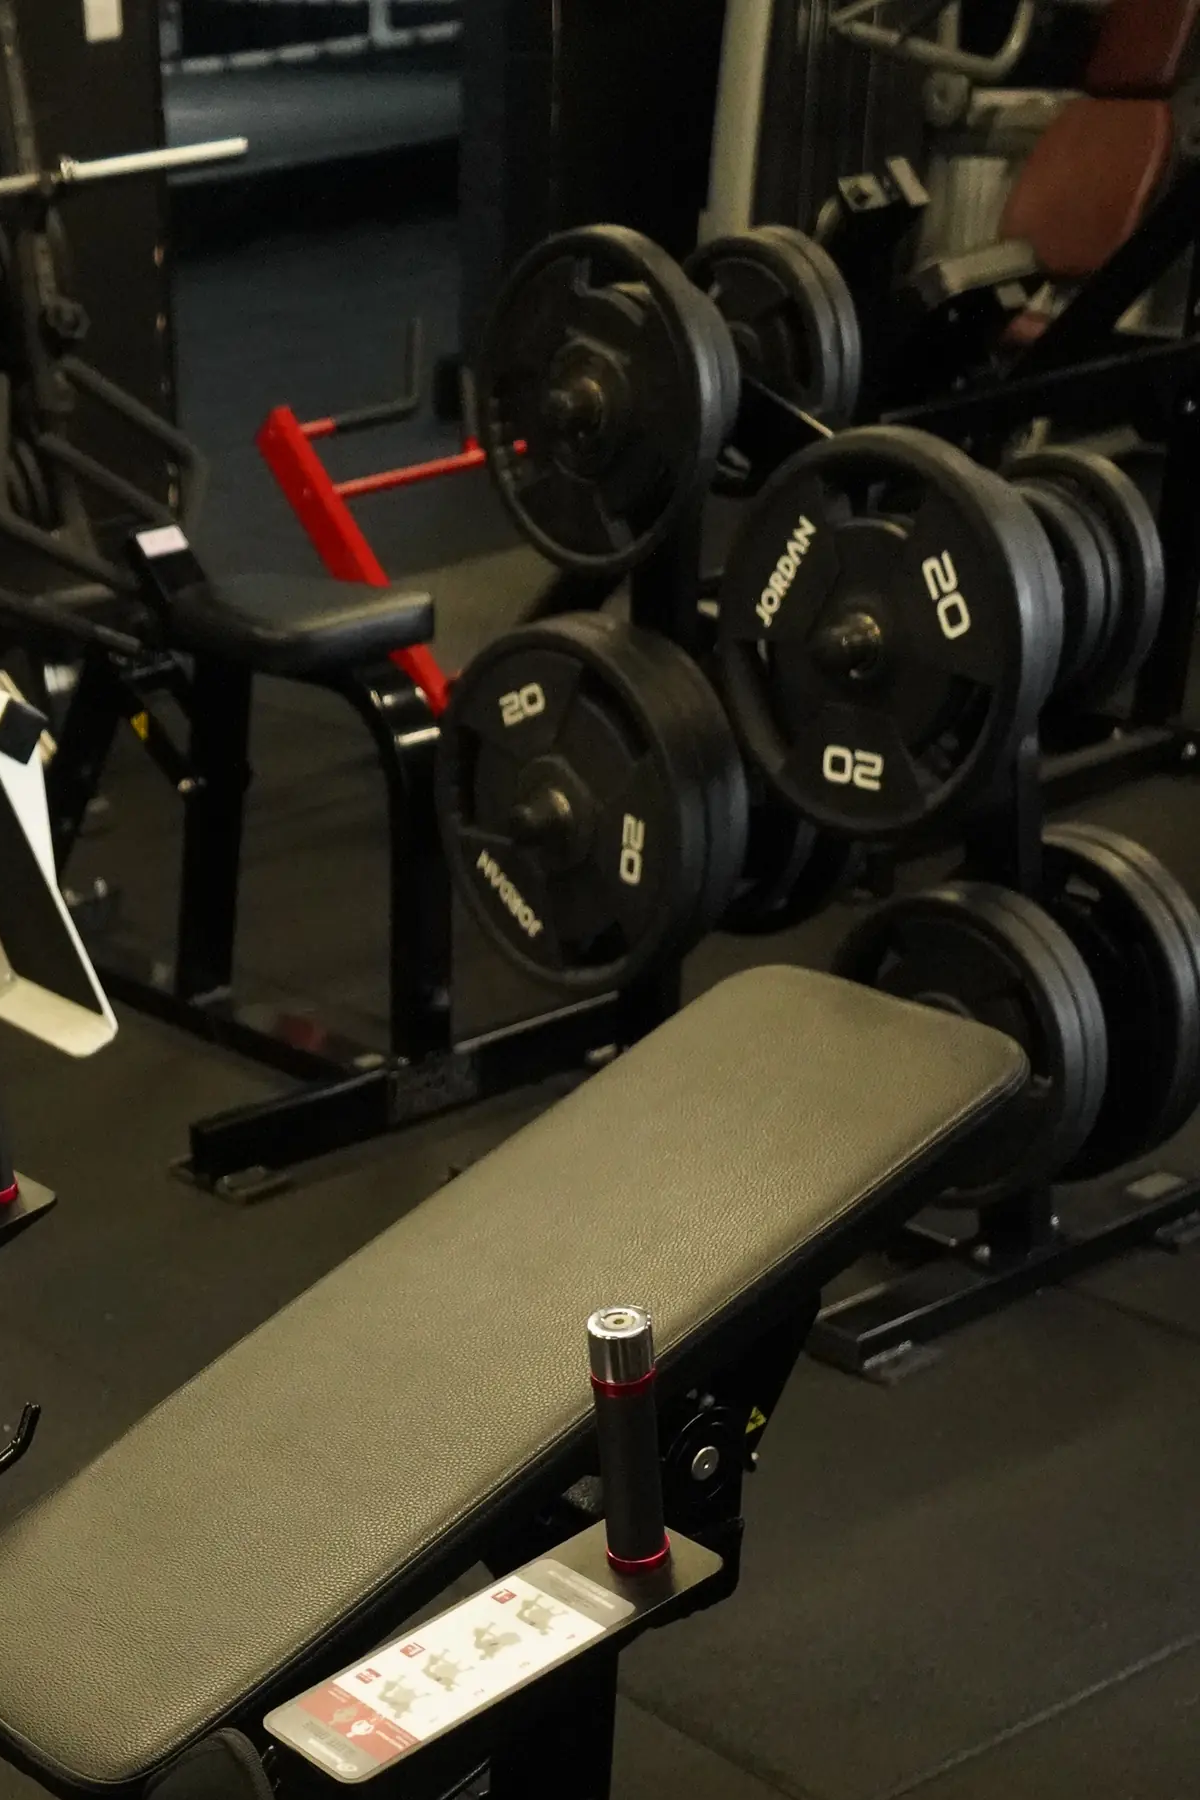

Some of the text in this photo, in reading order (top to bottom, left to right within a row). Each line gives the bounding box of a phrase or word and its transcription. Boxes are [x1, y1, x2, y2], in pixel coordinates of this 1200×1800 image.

[756, 514, 817, 628] JORDAN
[921, 550, 972, 640] 20
[498, 682, 546, 728] 20
[822, 743, 884, 792] 20
[619, 812, 646, 886] 20
[475, 849, 544, 938] JORDAN
